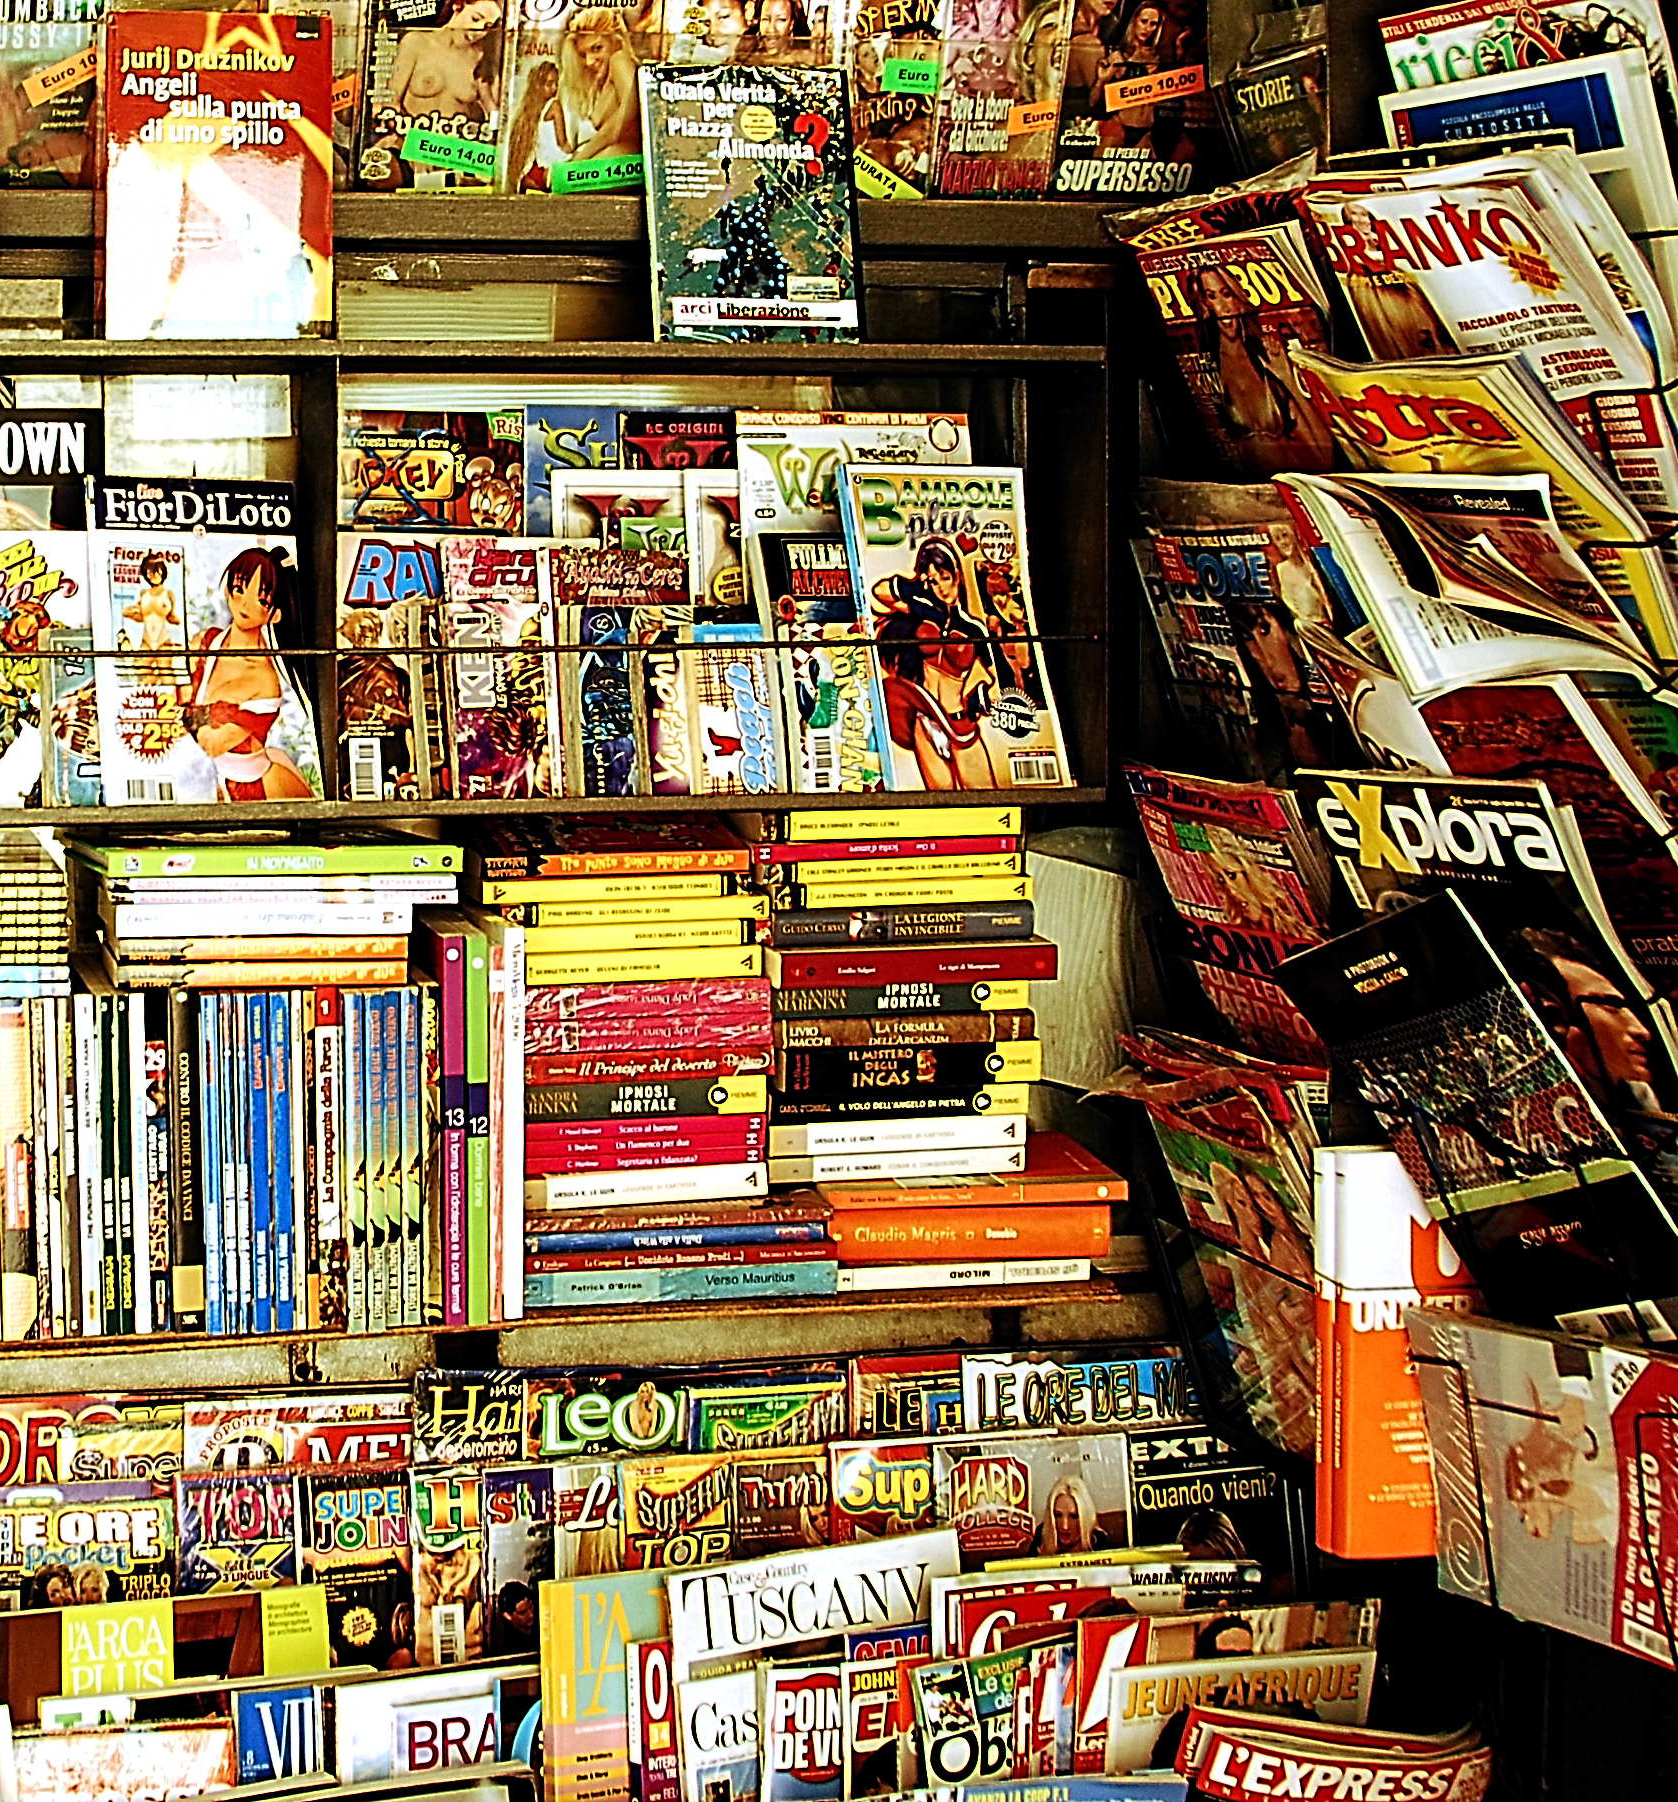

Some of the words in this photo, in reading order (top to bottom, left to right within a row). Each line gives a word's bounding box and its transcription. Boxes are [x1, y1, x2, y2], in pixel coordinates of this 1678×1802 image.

[1414, 12, 1465, 29] TENDENZE
[1467, 8, 1483, 19] DAI
[121, 47, 171, 74] Jurij
[175, 46, 295, 73] Družnikov
[120, 73, 199, 99] Angeli
[659, 81, 715, 104] Quale
[719, 81, 777, 104] Verità
[1119, 81, 1154, 99] Euro
[1157, 72, 1197, 94] 10,00
[1236, 76, 1295, 113] STORIE
[169, 95, 226, 119] sulla
[230, 99, 302, 124] punta
[702, 100, 738, 122] per
[140, 117, 163, 144] di
[168, 122, 216, 144] uno
[221, 120, 285, 149] spillo
[667, 117, 734, 140] Piazza
[418, 138, 454, 159] Euro
[456, 144, 496, 167] 14,00
[716, 141, 815, 162] Alimonda
[567, 165, 602, 184] Euro
[605, 161, 644, 178] 14,00
[1056, 159, 1193, 193] SUPERSESSO
[1129, 218, 1205, 251] FREE
[1318, 206, 1542, 276] BRANKO
[1226, 261, 1304, 307] BOY
[679, 300, 713, 317] arci
[717, 301, 810, 320] Liberazione
[1457, 309, 1530, 331] FACCIAMOLO
[1531, 303, 1582, 316] TANTRICO
[1541, 348, 1610, 366] ASTROLOGIA
[1544, 367, 1553, 378] E
[1555, 359, 1617, 375] SEDUZIONE
[1595, 395, 1636, 407] GIORNO
[1601, 408, 1640, 419] GIORNO
[1611, 433, 1647, 443] AGOSTO
[1619, 467, 1661, 478] MOZART
[103, 488, 292, 529] FiorDiLoto
[858, 478, 1014, 546] BAMBOLE
[905, 498, 980, 550] plus
[991, 711, 1016, 731] 380
[1316, 779, 1566, 876] eXplora
[262, 855, 325, 871] MOVIMENTO
[782, 923, 814, 934] GUIDO
[815, 922, 846, 933] CERVO
[894, 914, 911, 925] LA
[913, 912, 964, 924] LEGIONE
[894, 924, 964, 935] INVINCIBILE
[885, 982, 934, 996] IPNOSI
[877, 995, 941, 1009] MORTALE
[789, 1026, 819, 1037] LIVIO
[875, 1021, 891, 1034] LA
[894, 1022, 945, 1033] FORMULA
[789, 1035, 832, 1048] MACCHI
[865, 1049, 913, 1061] MISTERO
[177, 1051, 194, 1105] CONTRO
[579, 1062, 591, 1076] Il
[593, 1061, 646, 1077] Principe
[650, 1058, 670, 1072] del
[671, 1058, 717, 1071] deserto
[853, 1069, 910, 1087] INCAS
[618, 1086, 669, 1099] IPNOSI
[611, 1098, 677, 1113] MORTALE
[445, 1108, 465, 1127] 13
[468, 1115, 488, 1134] 12
[177, 1120, 193, 1167] CODICE
[177, 1189, 192, 1222] VINCI
[854, 1227, 907, 1243] Claudio
[911, 1226, 956, 1245] Magris
[705, 1273, 739, 1286] Verso
[742, 1271, 795, 1285] Mauritius
[951, 1457, 1028, 1506] HARD
[1139, 1479, 1214, 1511] Quando
[1222, 1472, 1276, 1500] vieni?
[315, 1517, 408, 1552] JOIN
[24, 1542, 130, 1570] Pocket
[765, 1562, 810, 1587] Country
[1625, 1555, 1637, 1586] non
[120, 1574, 171, 1592] TRIPLO
[266, 1600, 301, 1613] Monografie
[680, 1562, 930, 1655] TUSCANY
[1621, 1592, 1635, 1615] Da
[1636, 1600, 1655, 1626] IL
[67, 1616, 167, 1665] l'ARCA
[71, 1660, 165, 1695] PLUS
[1122, 1672, 1218, 1721] JEUNE
[1223, 1661, 1361, 1708] AFRIQUE
[1208, 1739, 1456, 1801] L'EXPRESS
